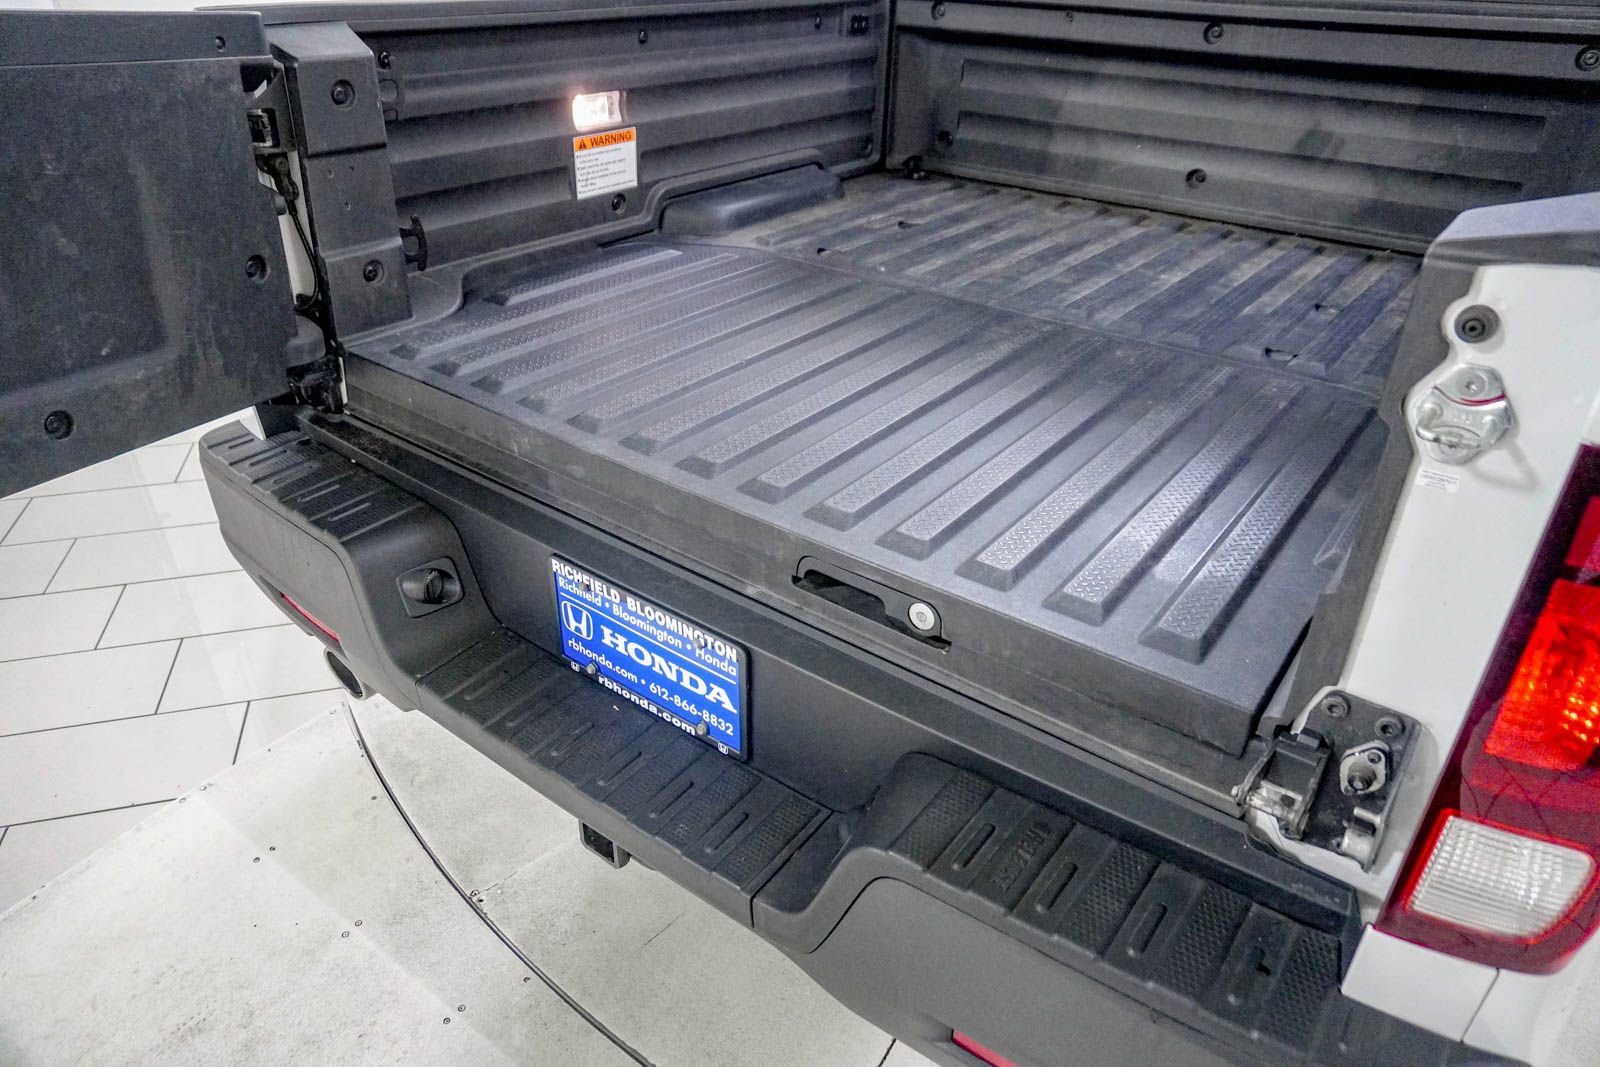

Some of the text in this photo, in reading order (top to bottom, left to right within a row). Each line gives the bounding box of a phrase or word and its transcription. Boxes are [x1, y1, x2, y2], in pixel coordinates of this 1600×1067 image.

[591, 130, 632, 147] WARNING
[551, 558, 737, 663] RICHFIELD BLOOMINGTON
[612, 604, 682, 649] Bloomington
[695, 646, 736, 677] Honda
[568, 638, 734, 736] rbhonda.com 612-866-8832
[598, 675, 696, 736] rbhonda.com
[601, 625, 738, 714] HONDA
